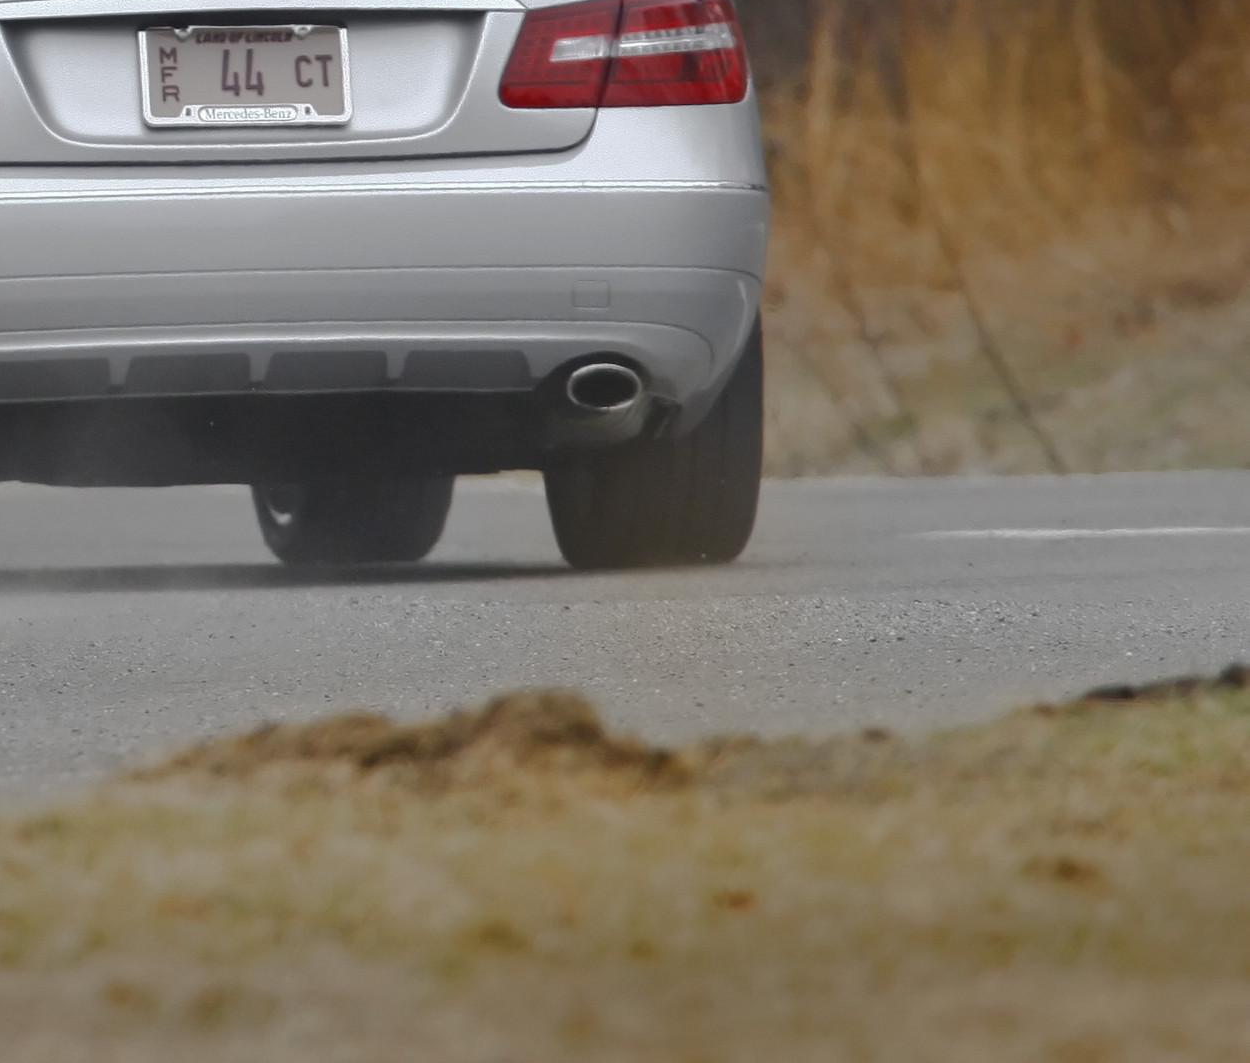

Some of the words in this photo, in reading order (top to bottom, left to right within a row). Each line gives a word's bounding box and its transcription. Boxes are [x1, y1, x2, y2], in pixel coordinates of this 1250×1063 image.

[195, 31, 226, 44] LAND
[228, 31, 244, 43] OF
[245, 30, 294, 43] LINCOLN
[221, 48, 265, 96] 44
[294, 54, 333, 88] CT
[204, 107, 293, 121] Mercedes-Benz
